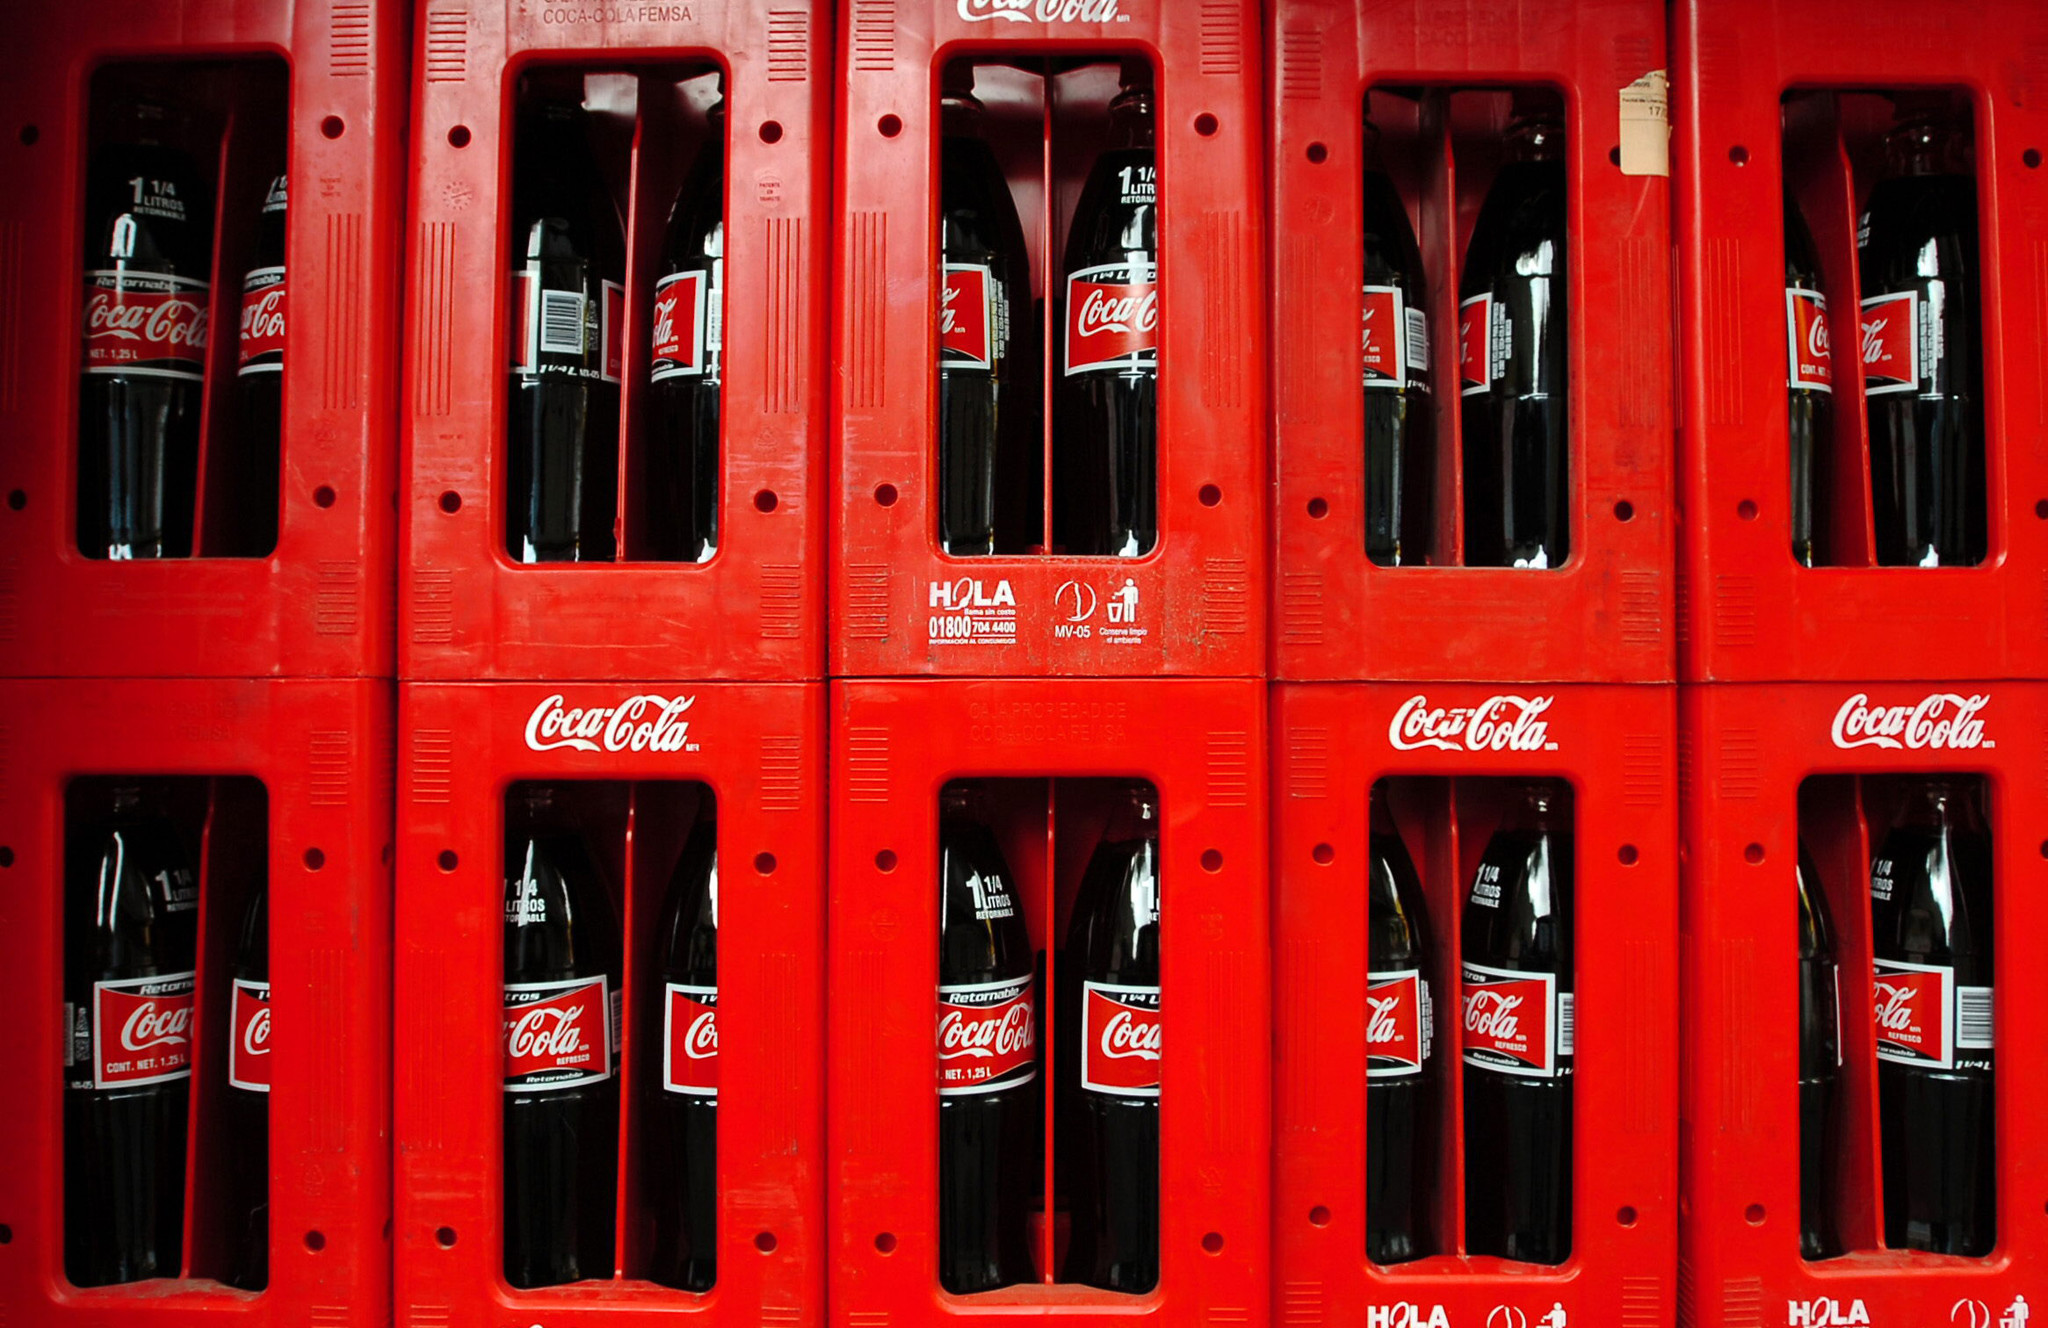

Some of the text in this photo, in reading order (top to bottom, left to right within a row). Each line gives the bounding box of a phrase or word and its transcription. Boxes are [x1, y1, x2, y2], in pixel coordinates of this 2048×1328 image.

[543, 6, 692, 24] COCA-COLA FEMSA
[128, 177, 176, 205] 1 1/4
[1117, 165, 1132, 195] 1
[1131, 182, 1156, 195] LITR
[144, 195, 185, 212] LITROS
[929, 577, 1016, 611] HOLA
[929, 616, 1017, 638] 01800 704 4400
[1055, 625, 1091, 639] MV-05
[524, 693, 696, 752] Coca-Cola
[1388, 694, 1555, 751] Coca-Cola
[1831, 692, 1991, 749] Coca-Cola
[154, 868, 172, 902] 1
[966, 874, 1003, 909] 1 1/4
[982, 893, 1012, 909] LITROS
[949, 987, 1020, 1004] Retornable
[106, 1060, 135, 1074] CONT.
[137, 1057, 159, 1071] NET.
[526, 1071, 584, 1084] Retornable
[1367, 1301, 1450, 1328] HOLA
[1788, 1297, 1870, 1328] HOLA
